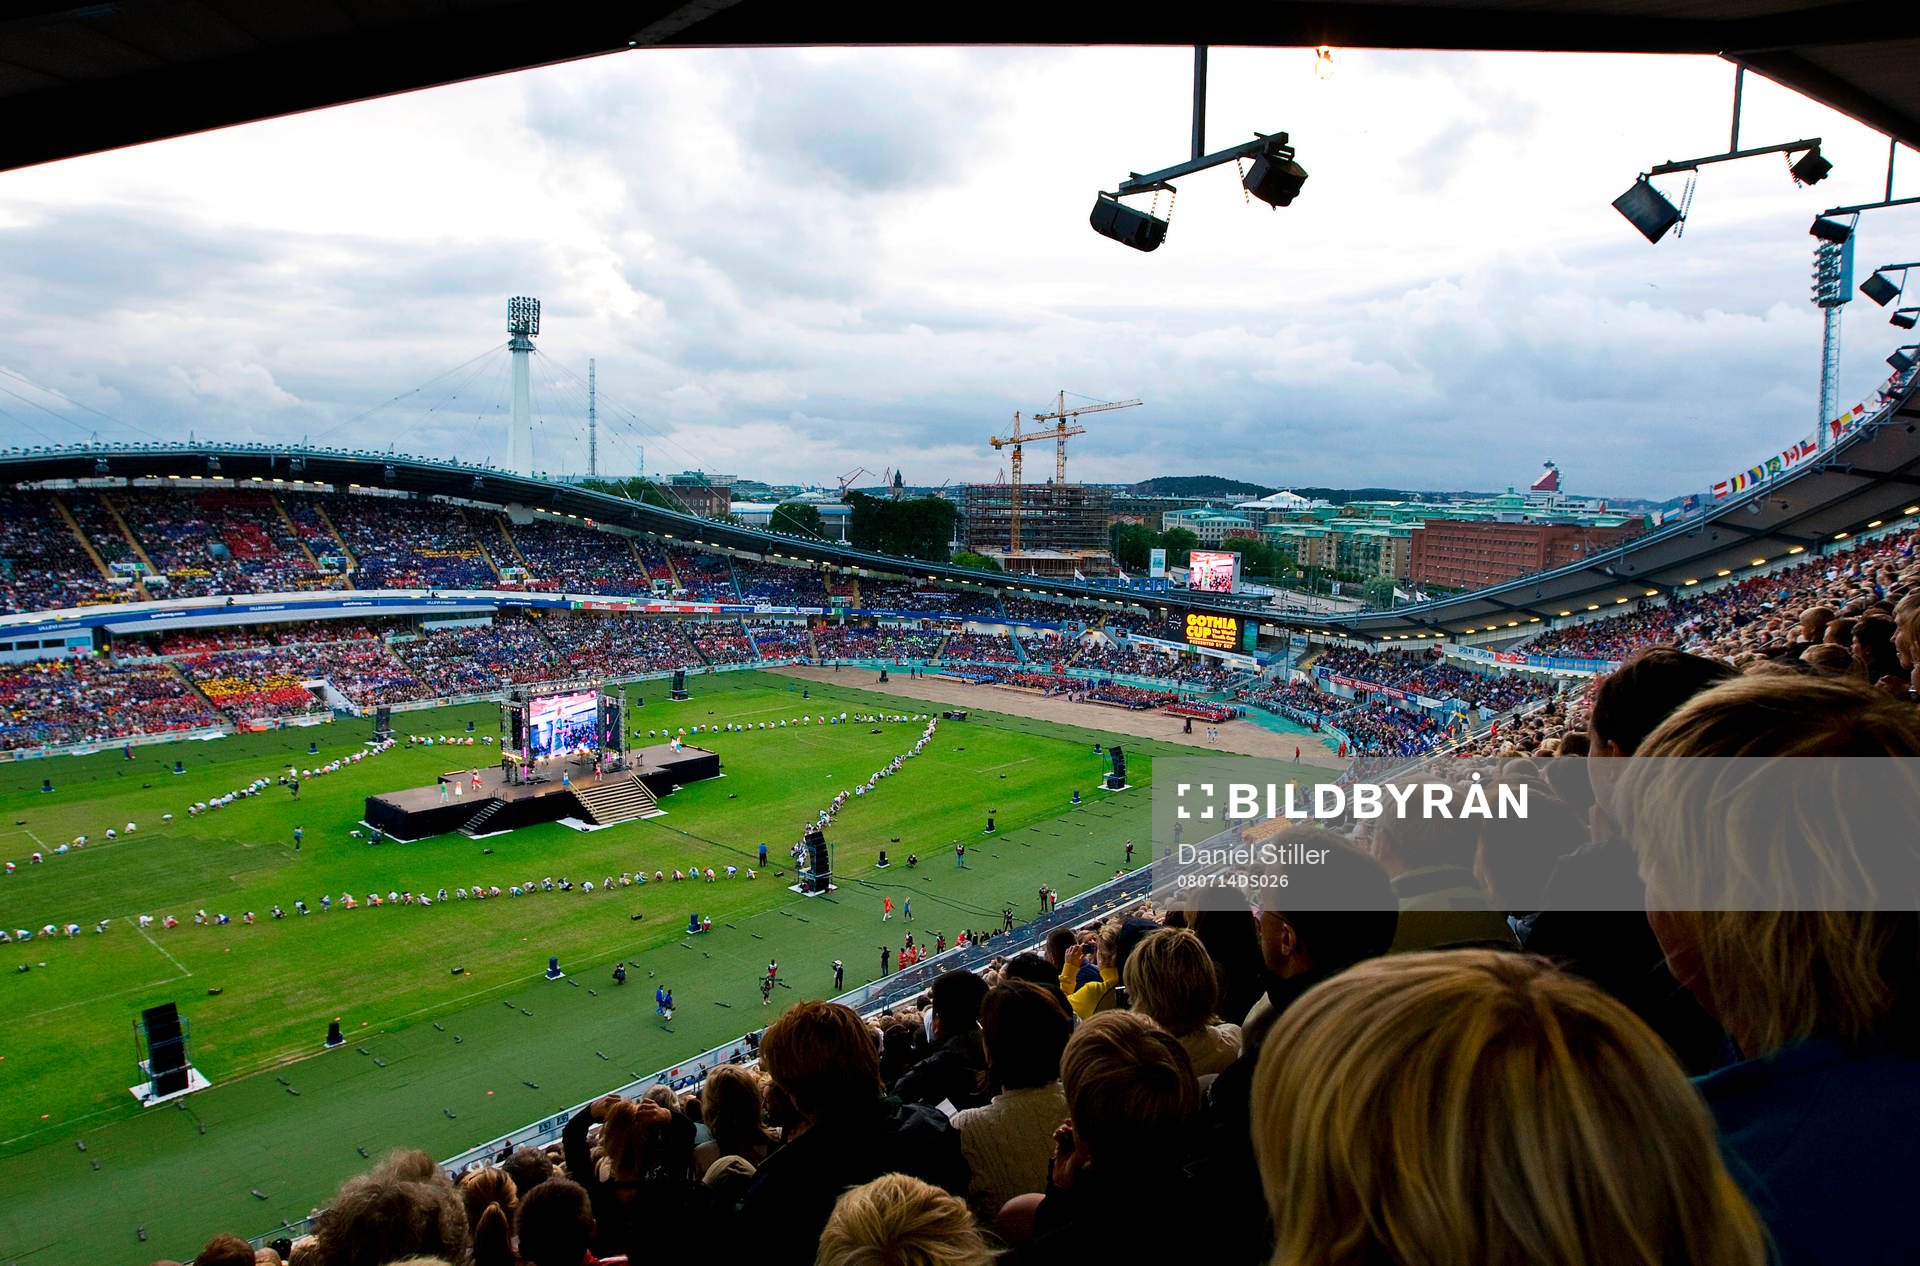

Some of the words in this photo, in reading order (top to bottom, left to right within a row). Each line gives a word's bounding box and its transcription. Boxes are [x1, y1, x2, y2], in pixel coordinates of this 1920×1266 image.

[1186, 614, 1237, 630] GOTHIA
[1186, 626, 1211, 639] CUP
[1335, 676, 1353, 686] TOYOTA
[1361, 683, 1379, 692] TOYOTA
[1388, 690, 1404, 698] TOYOTA
